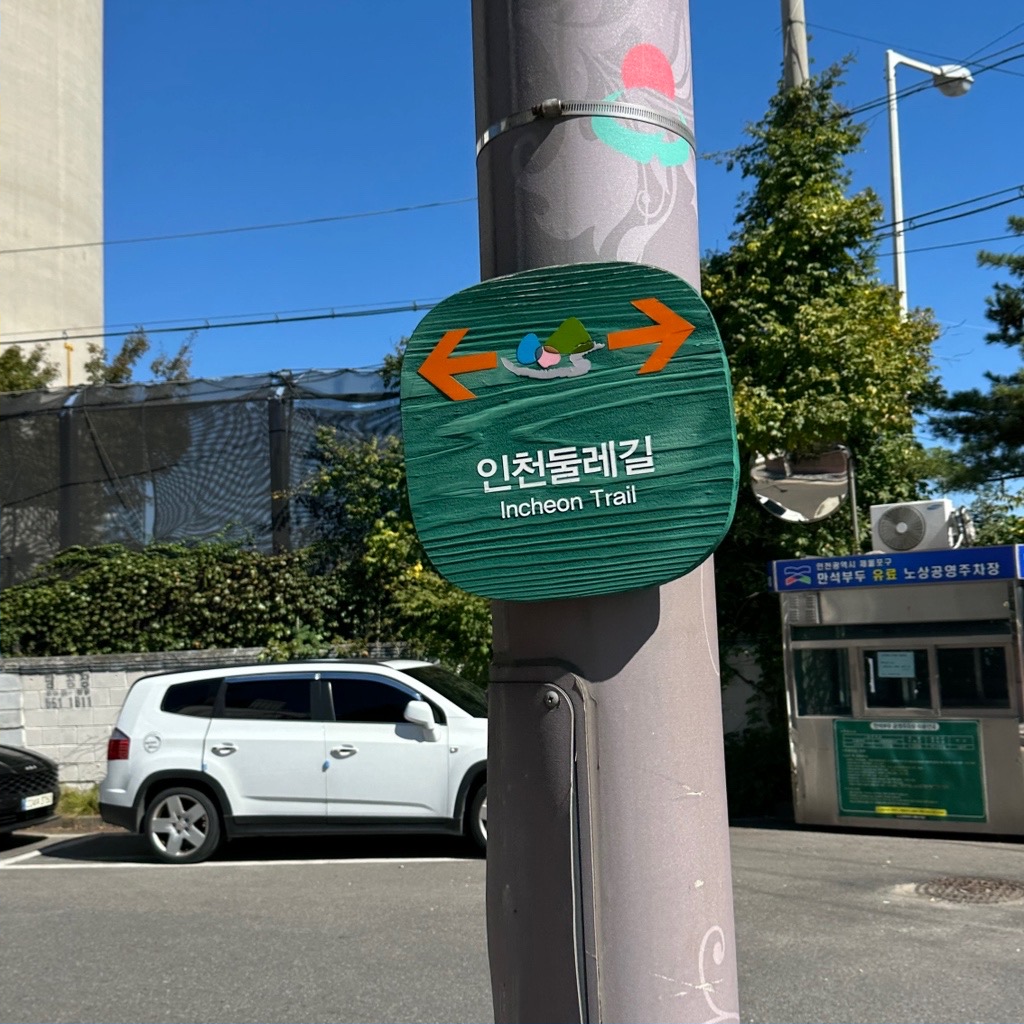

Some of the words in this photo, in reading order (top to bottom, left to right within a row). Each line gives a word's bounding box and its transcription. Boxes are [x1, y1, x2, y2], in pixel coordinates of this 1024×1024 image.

[477, 435, 656, 494] 인천둘레길
[499, 495, 584, 520] Incheon
[589, 485, 638, 509] Trail
[817, 570, 866, 585] 만석부두
[904, 561, 1000, 580] 노상공영주차장
